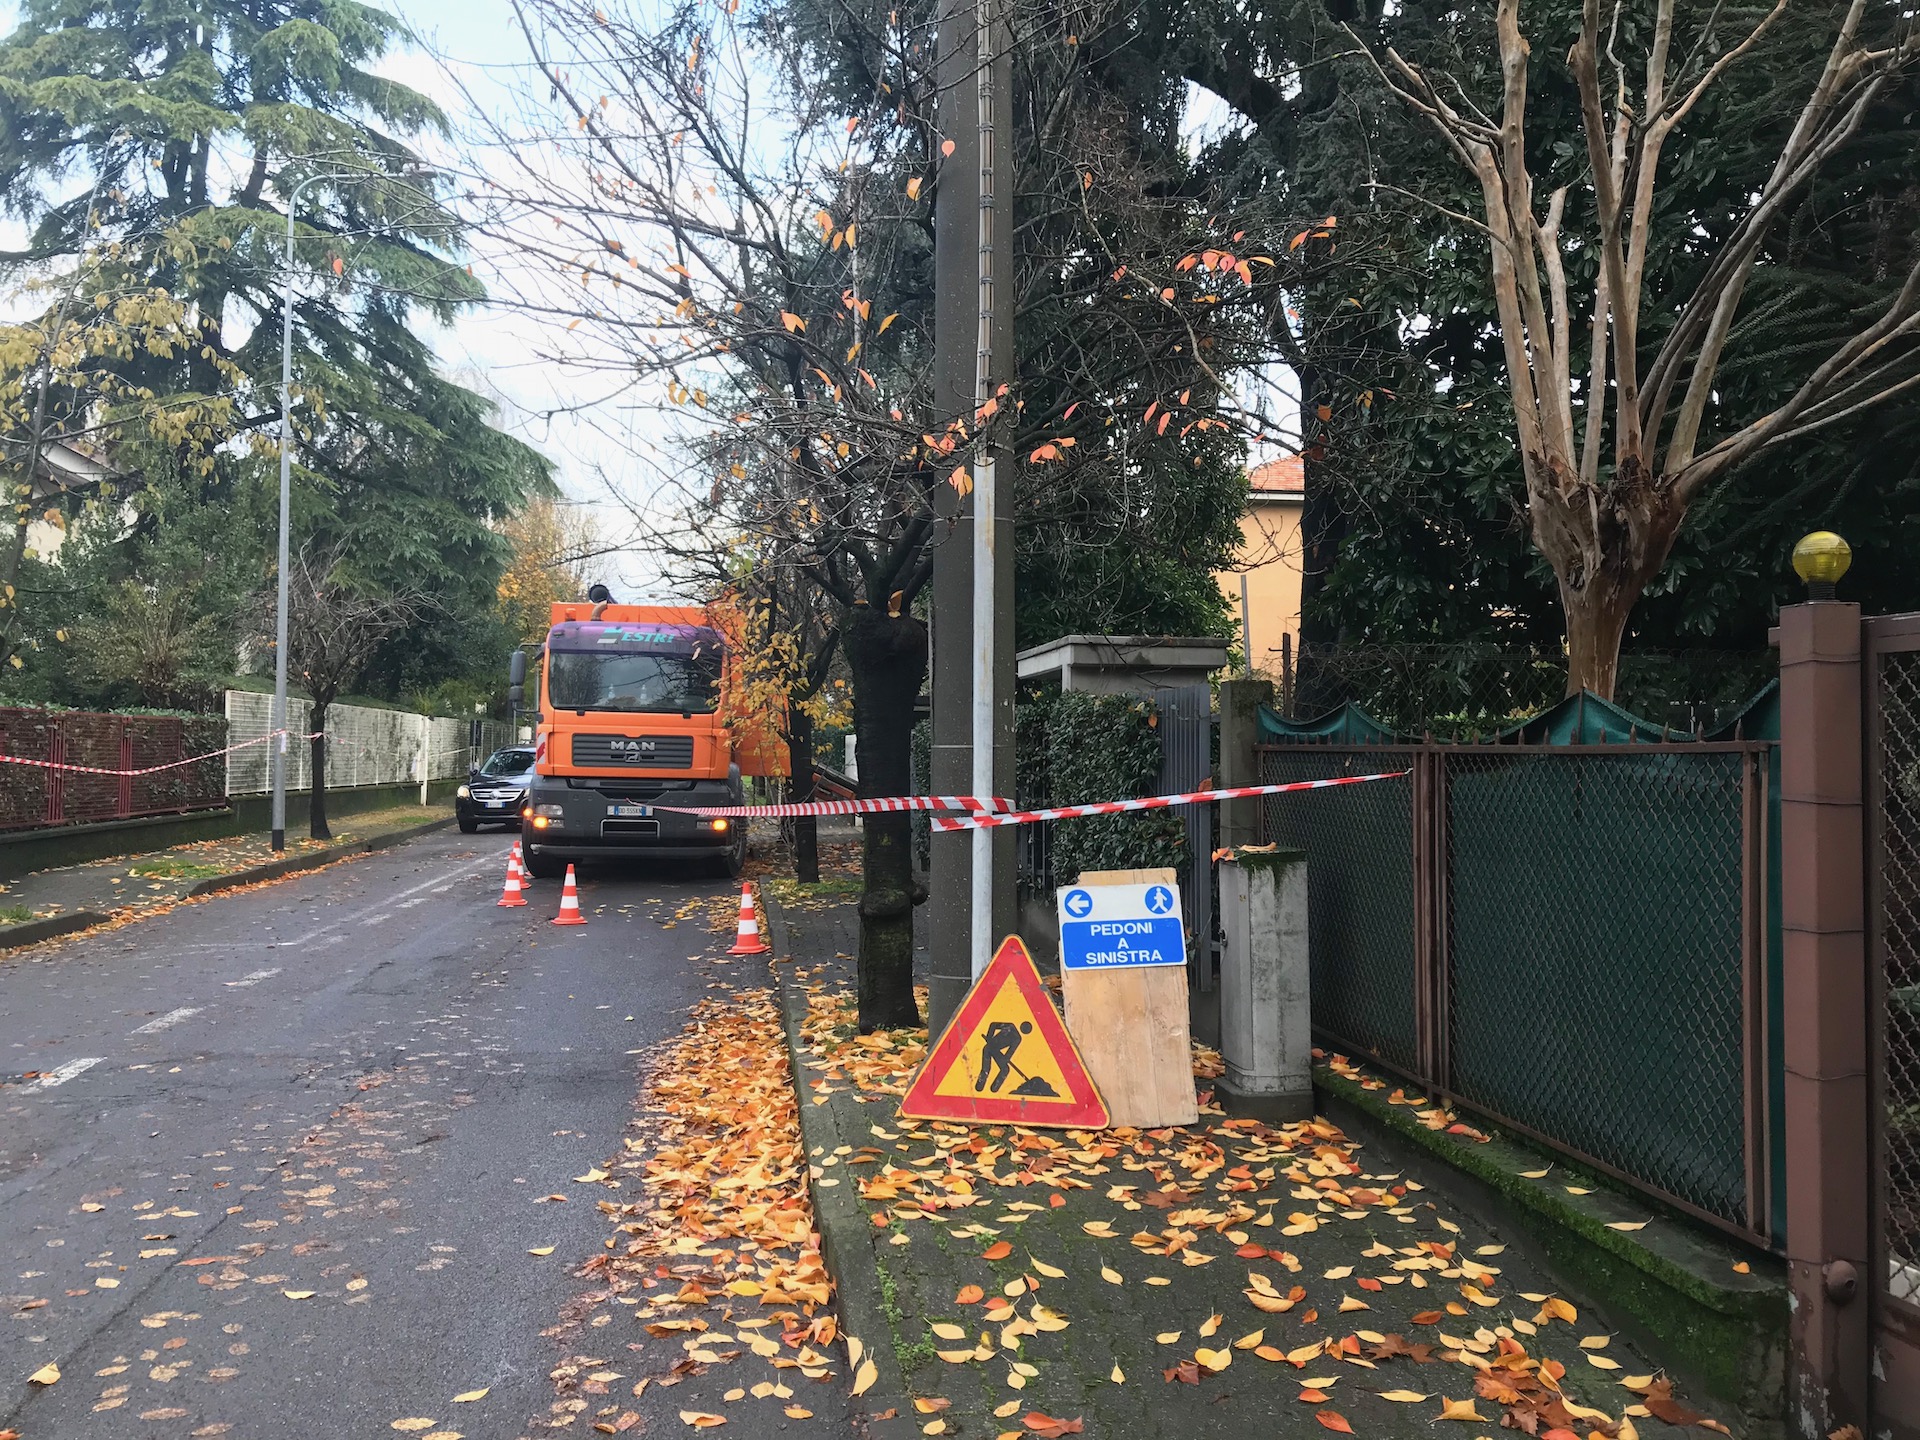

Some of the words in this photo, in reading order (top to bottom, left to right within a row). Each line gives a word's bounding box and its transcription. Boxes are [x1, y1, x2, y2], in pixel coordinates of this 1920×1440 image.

[611, 741, 656, 751] MAN
[1090, 922, 1152, 936] PEDONI
[1117, 938, 1129, 949] A
[1086, 949, 1163, 964] SINISTRA
